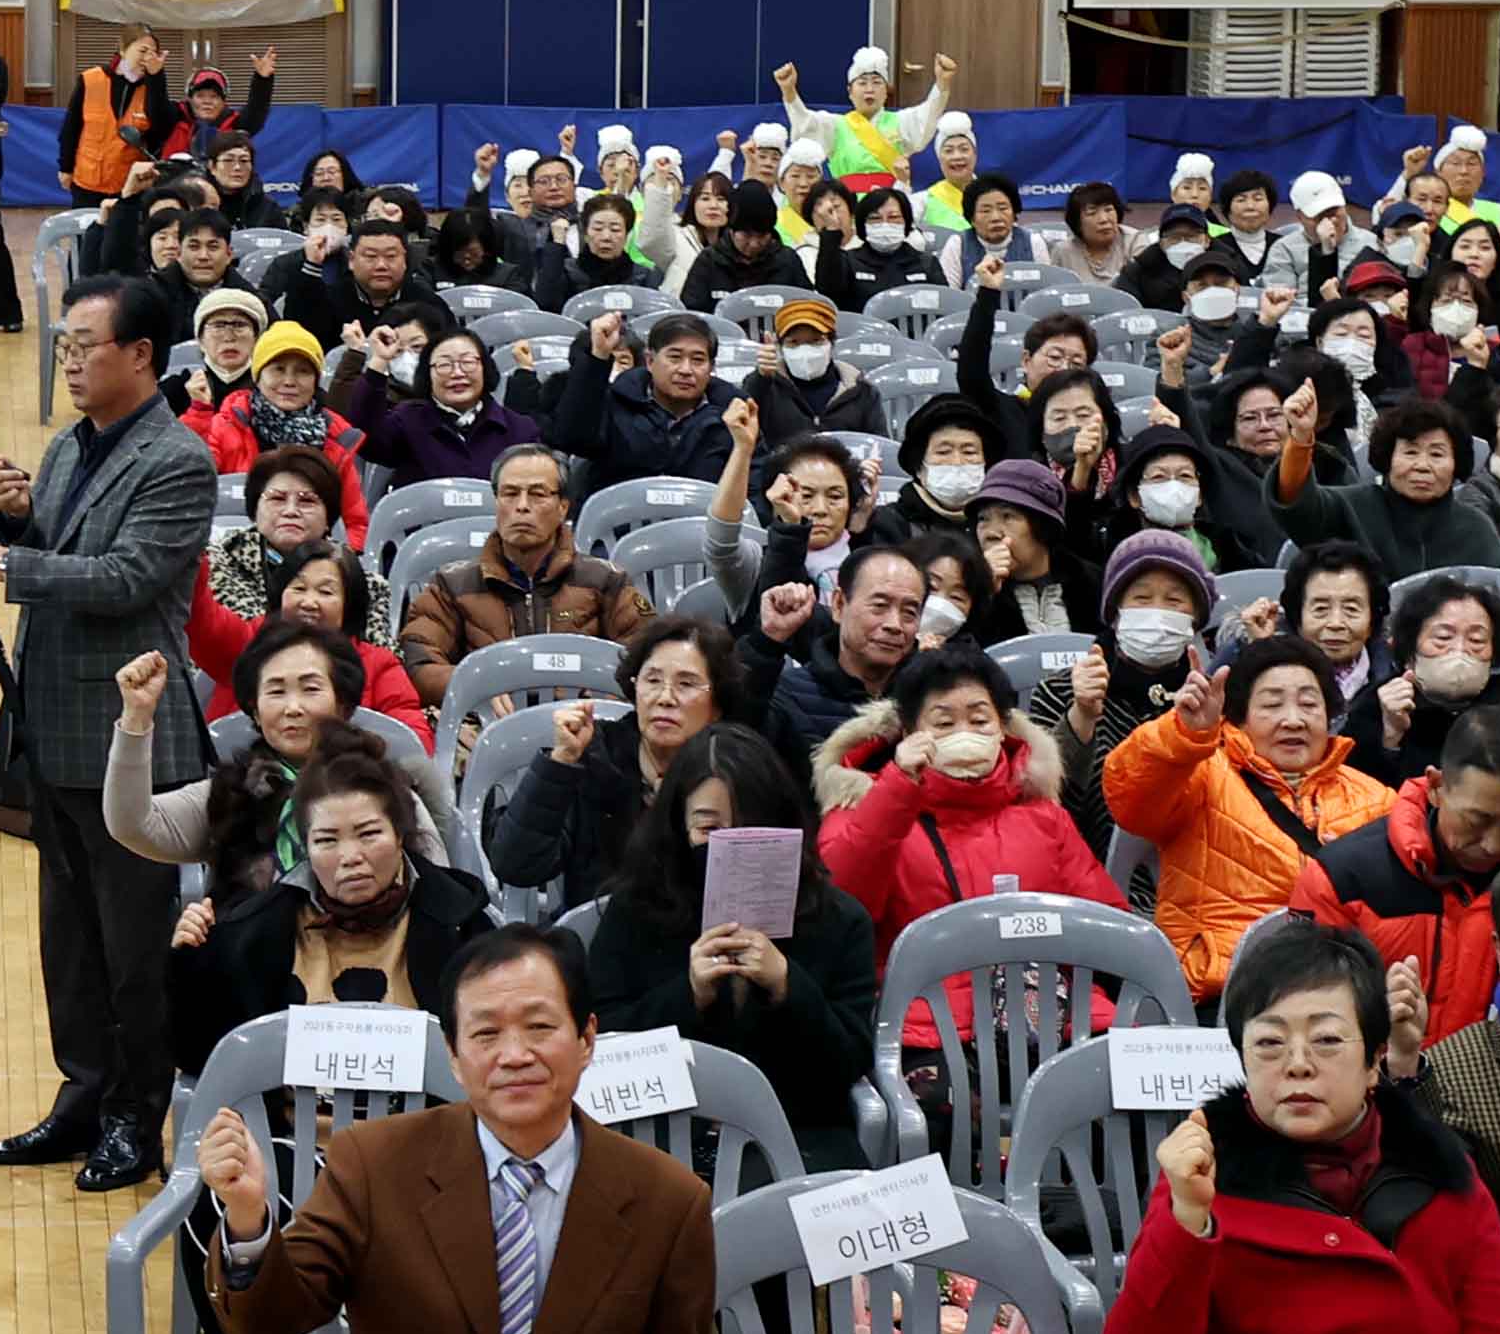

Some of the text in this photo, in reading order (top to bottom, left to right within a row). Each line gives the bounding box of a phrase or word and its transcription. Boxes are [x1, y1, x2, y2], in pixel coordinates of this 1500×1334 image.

[549, 655, 568, 668] 48
[1010, 915, 1047, 936] 238
[314, 1051, 395, 1083] 내빈석
[590, 1075, 668, 1115] 내빈석
[838, 1210, 931, 1261] 이대형
